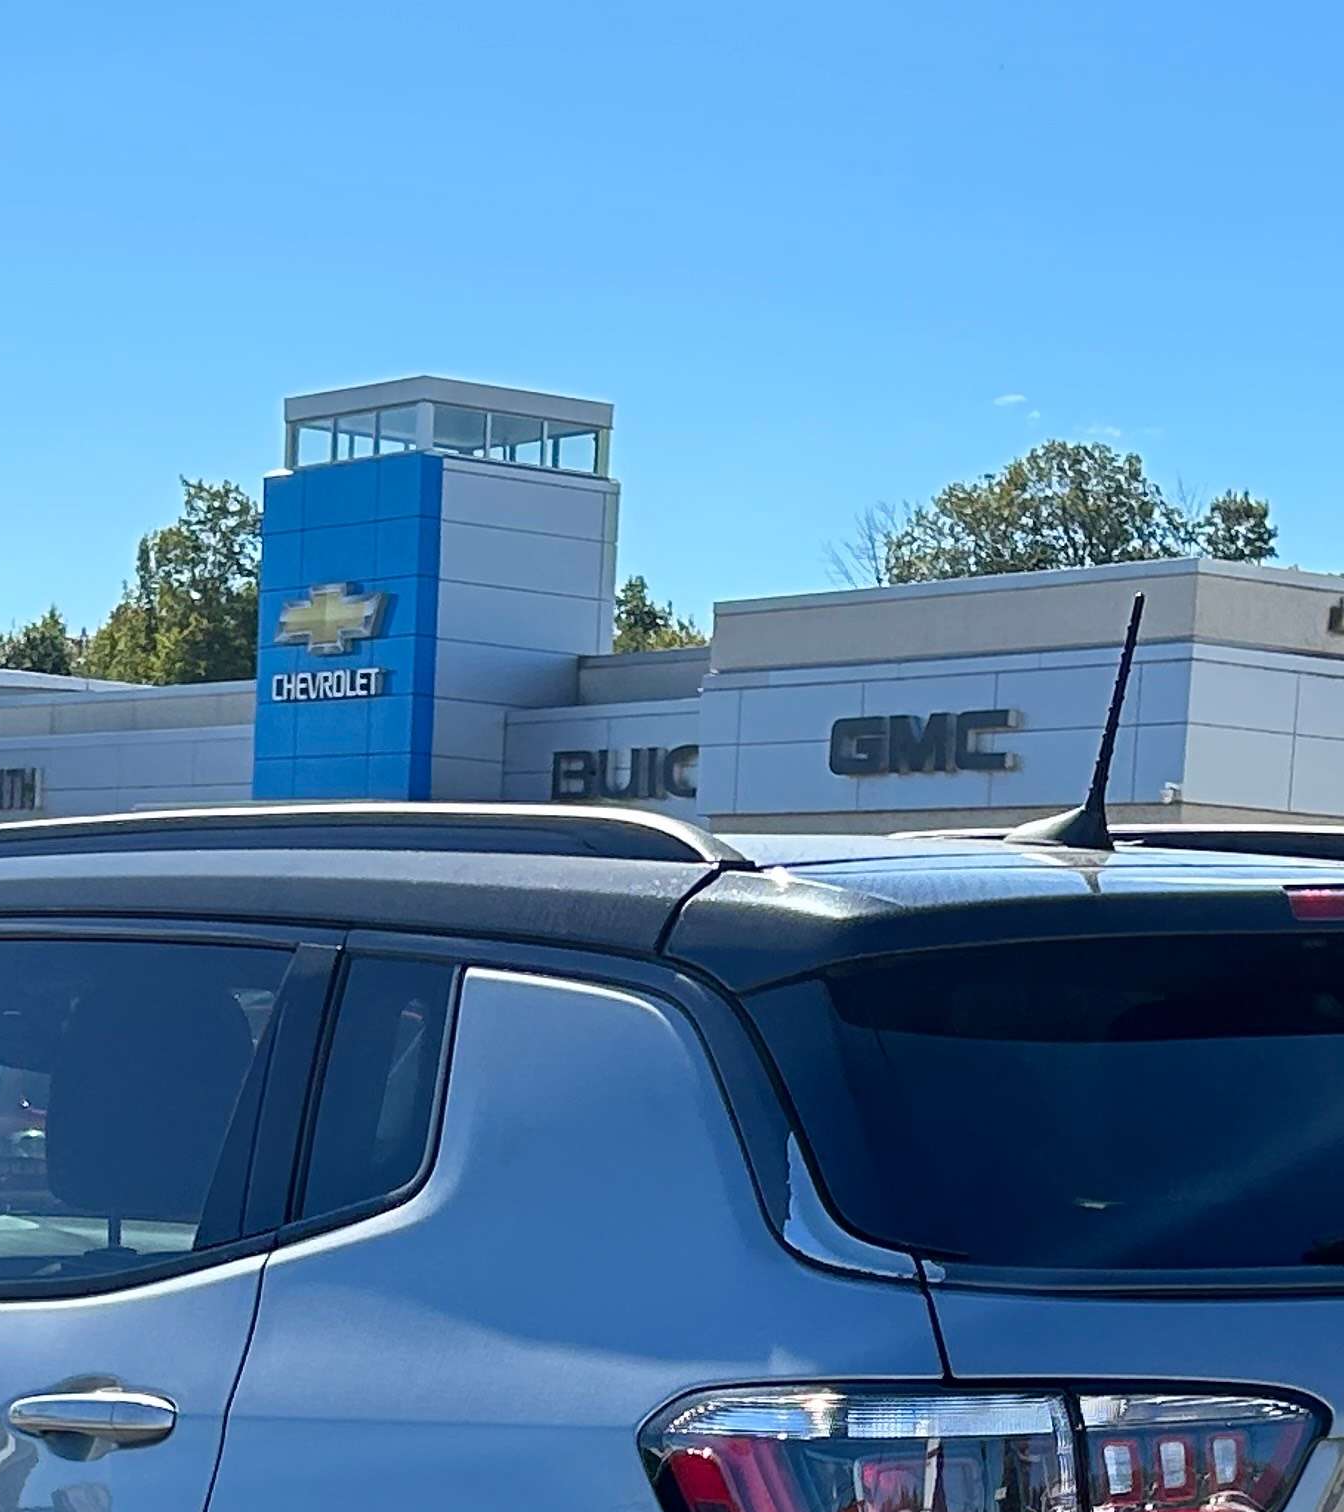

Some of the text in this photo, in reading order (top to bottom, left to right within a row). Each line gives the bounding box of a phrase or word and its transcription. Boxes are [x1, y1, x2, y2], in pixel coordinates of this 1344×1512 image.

[271, 668, 382, 701] CHEVROLET
[827, 708, 1021, 777] GMC
[550, 744, 700, 801] BUIC
